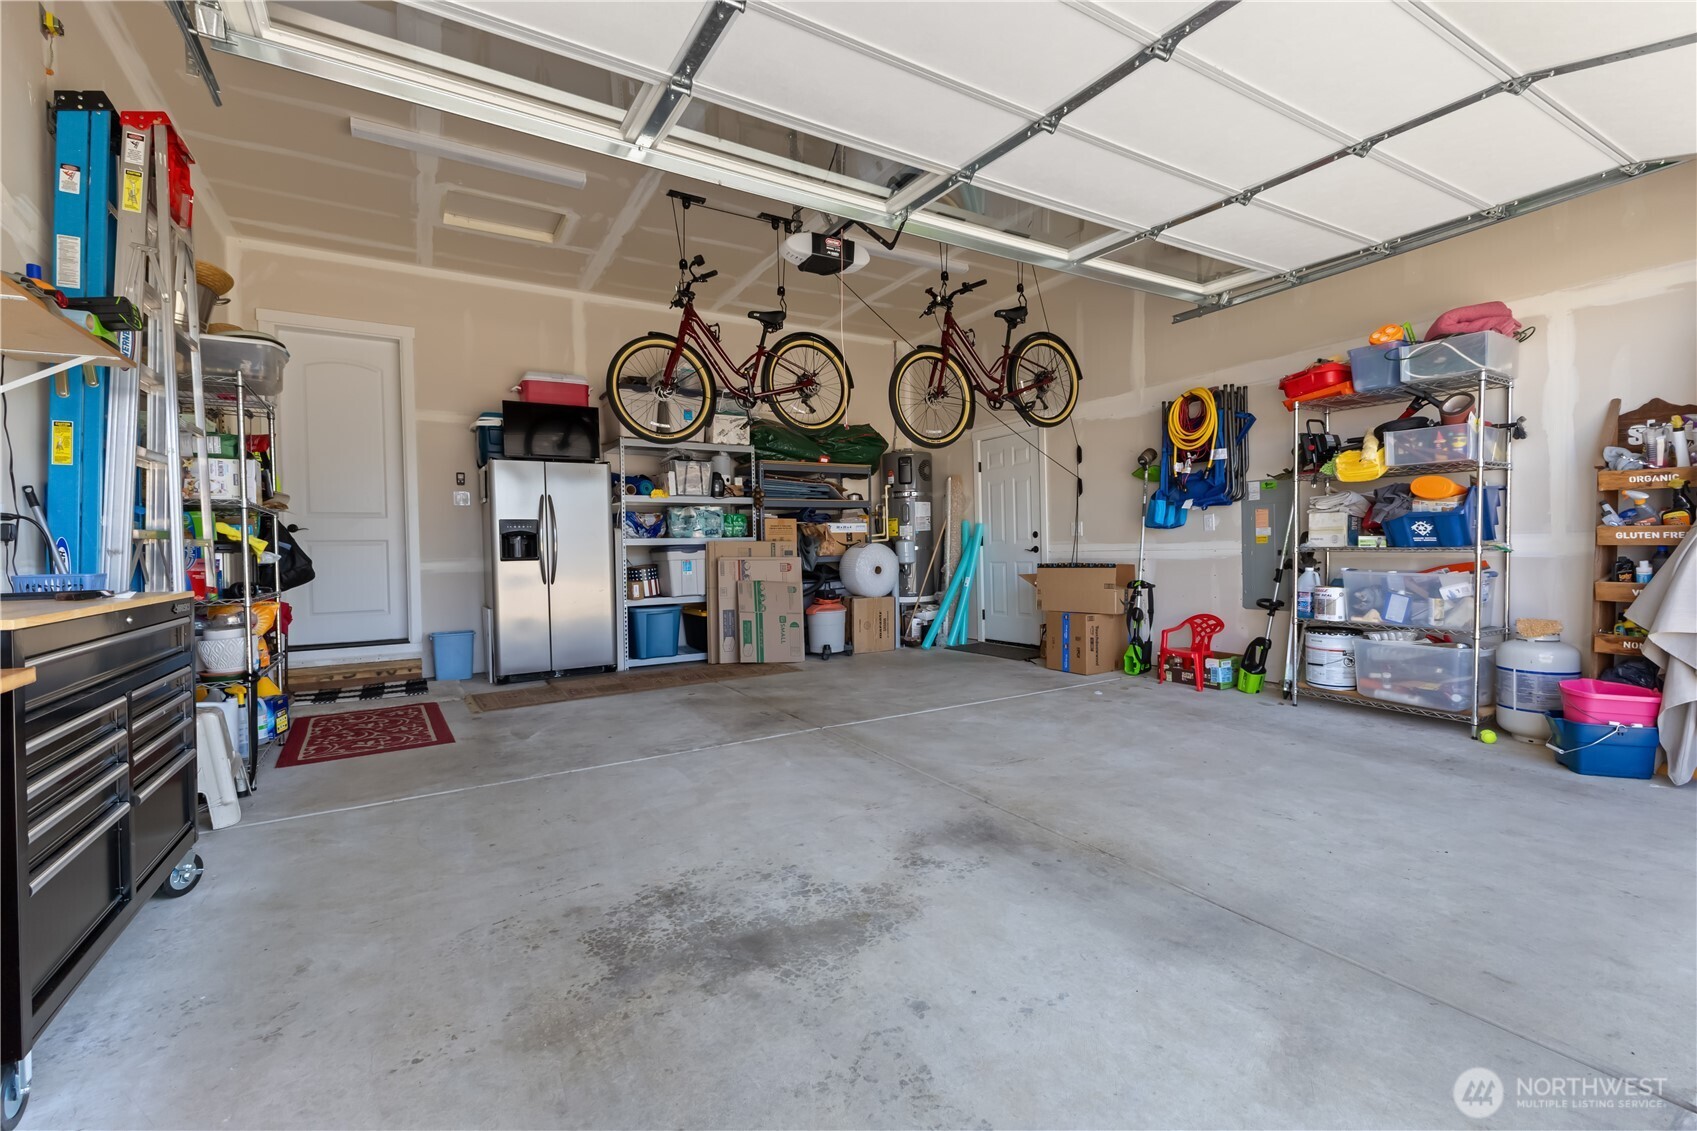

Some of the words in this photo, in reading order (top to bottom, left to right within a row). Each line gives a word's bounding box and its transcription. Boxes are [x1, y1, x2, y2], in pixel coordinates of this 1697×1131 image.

[1628, 473, 1680, 483] ORGANIC
[1615, 531, 1660, 539] GLUTEN
[1662, 531, 1686, 539] FRE
[1623, 641, 1642, 650] NO
